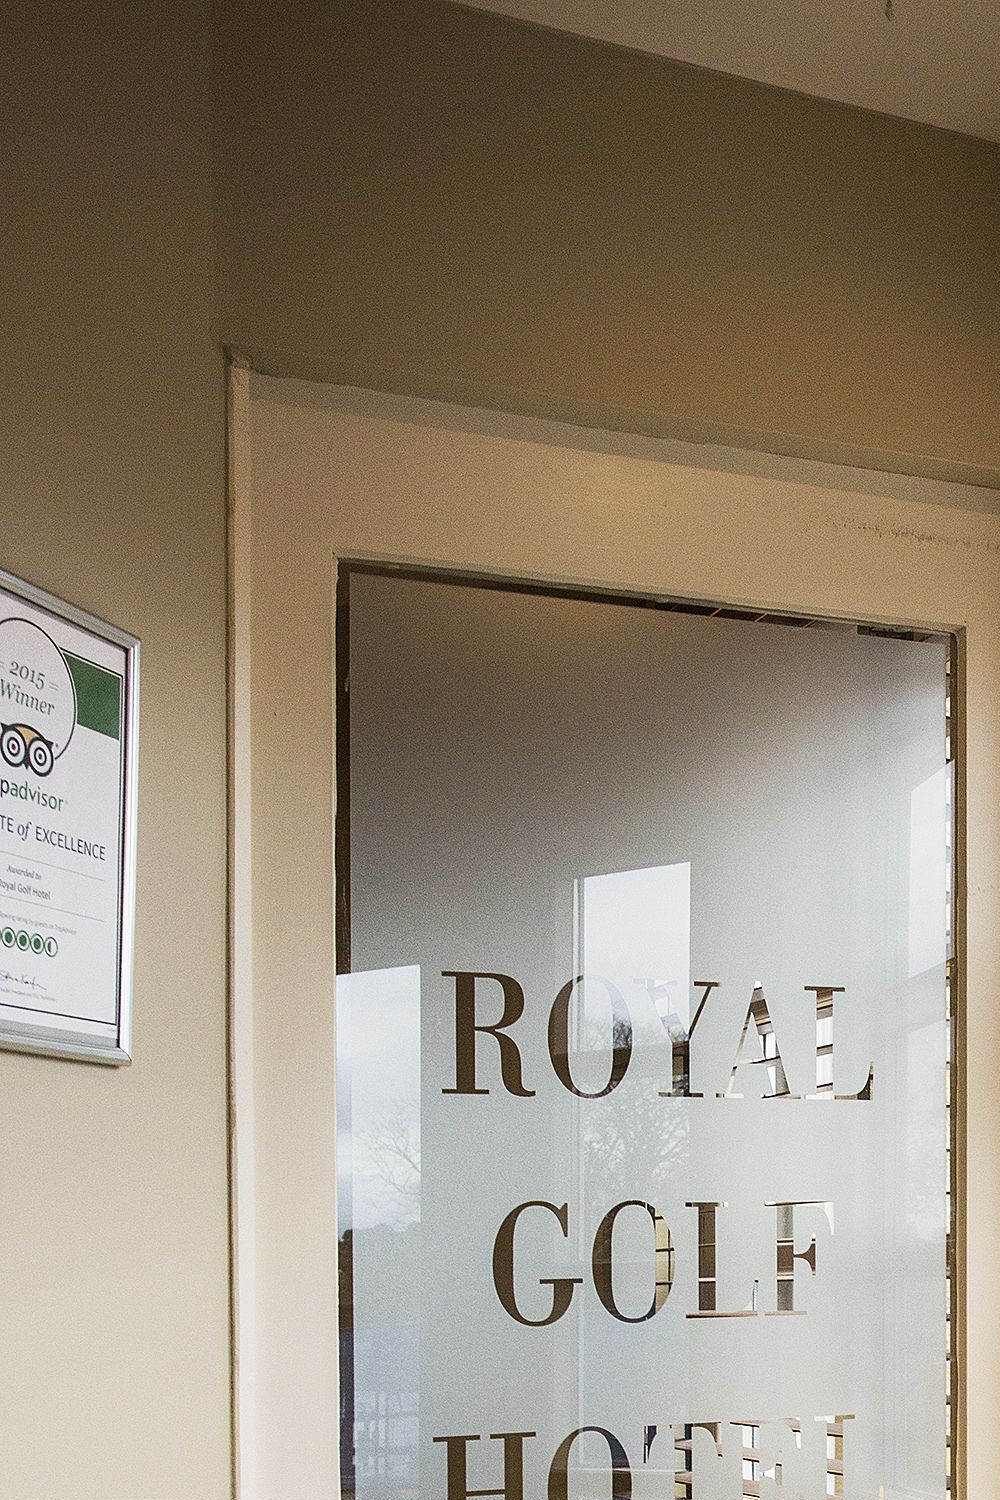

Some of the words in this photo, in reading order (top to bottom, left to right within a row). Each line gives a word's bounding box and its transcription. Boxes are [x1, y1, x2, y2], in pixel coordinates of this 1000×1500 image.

[10, 661, 45, 690] 2015
[0, 679, 54, 715] Winner
[17, 822, 32, 840] of
[36, 826, 105, 860] EXCELLENCE
[33, 888, 50, 900] Hotel
[441, 971, 873, 1101] ROYAL
[492, 1200, 835, 1327] GOLF
